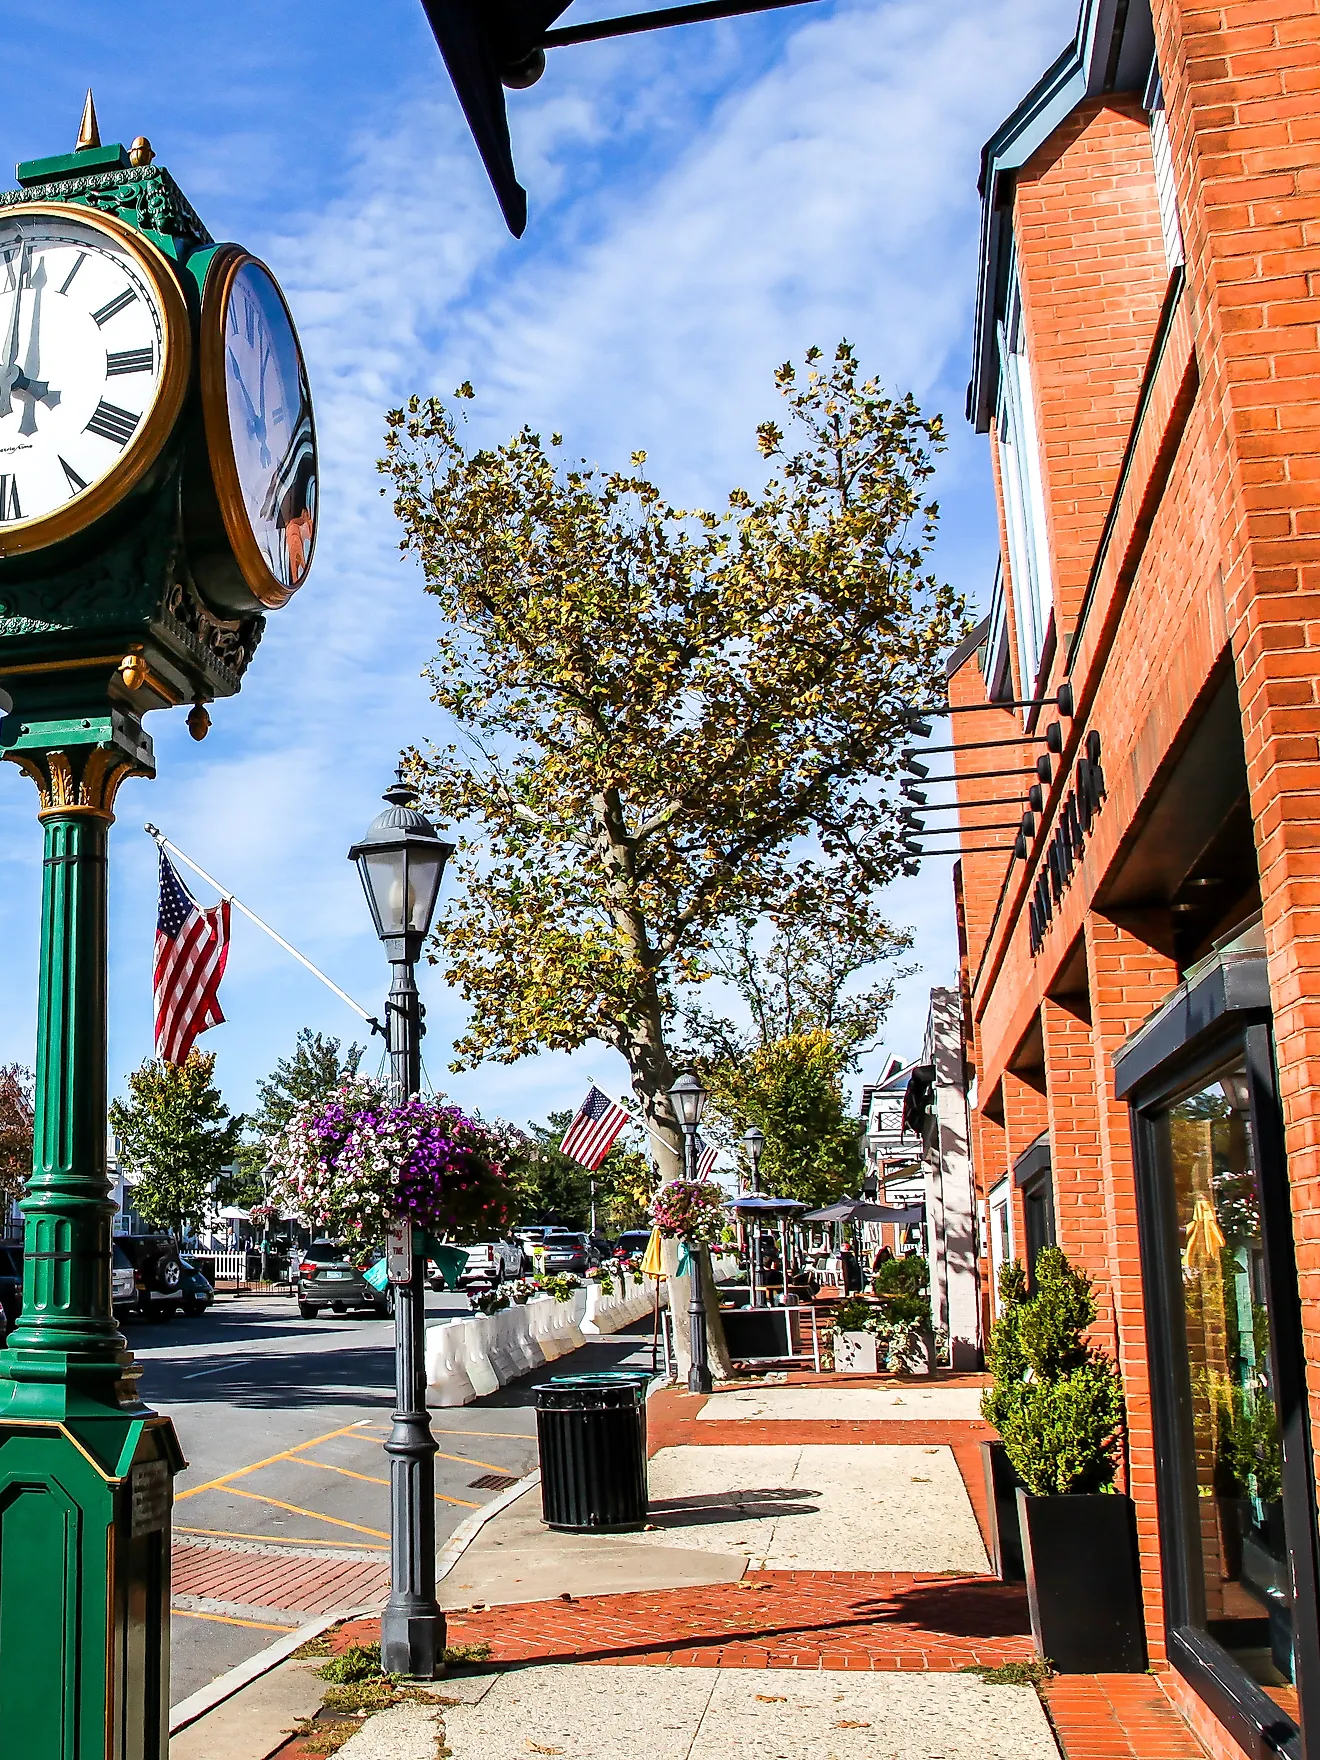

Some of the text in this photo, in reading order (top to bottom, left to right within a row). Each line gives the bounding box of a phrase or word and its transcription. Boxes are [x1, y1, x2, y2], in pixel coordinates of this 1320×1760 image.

[0, 245, 37, 295] XI
[89, 283, 140, 330] II
[106, 340, 154, 380] III
[57, 454, 93, 499] V
